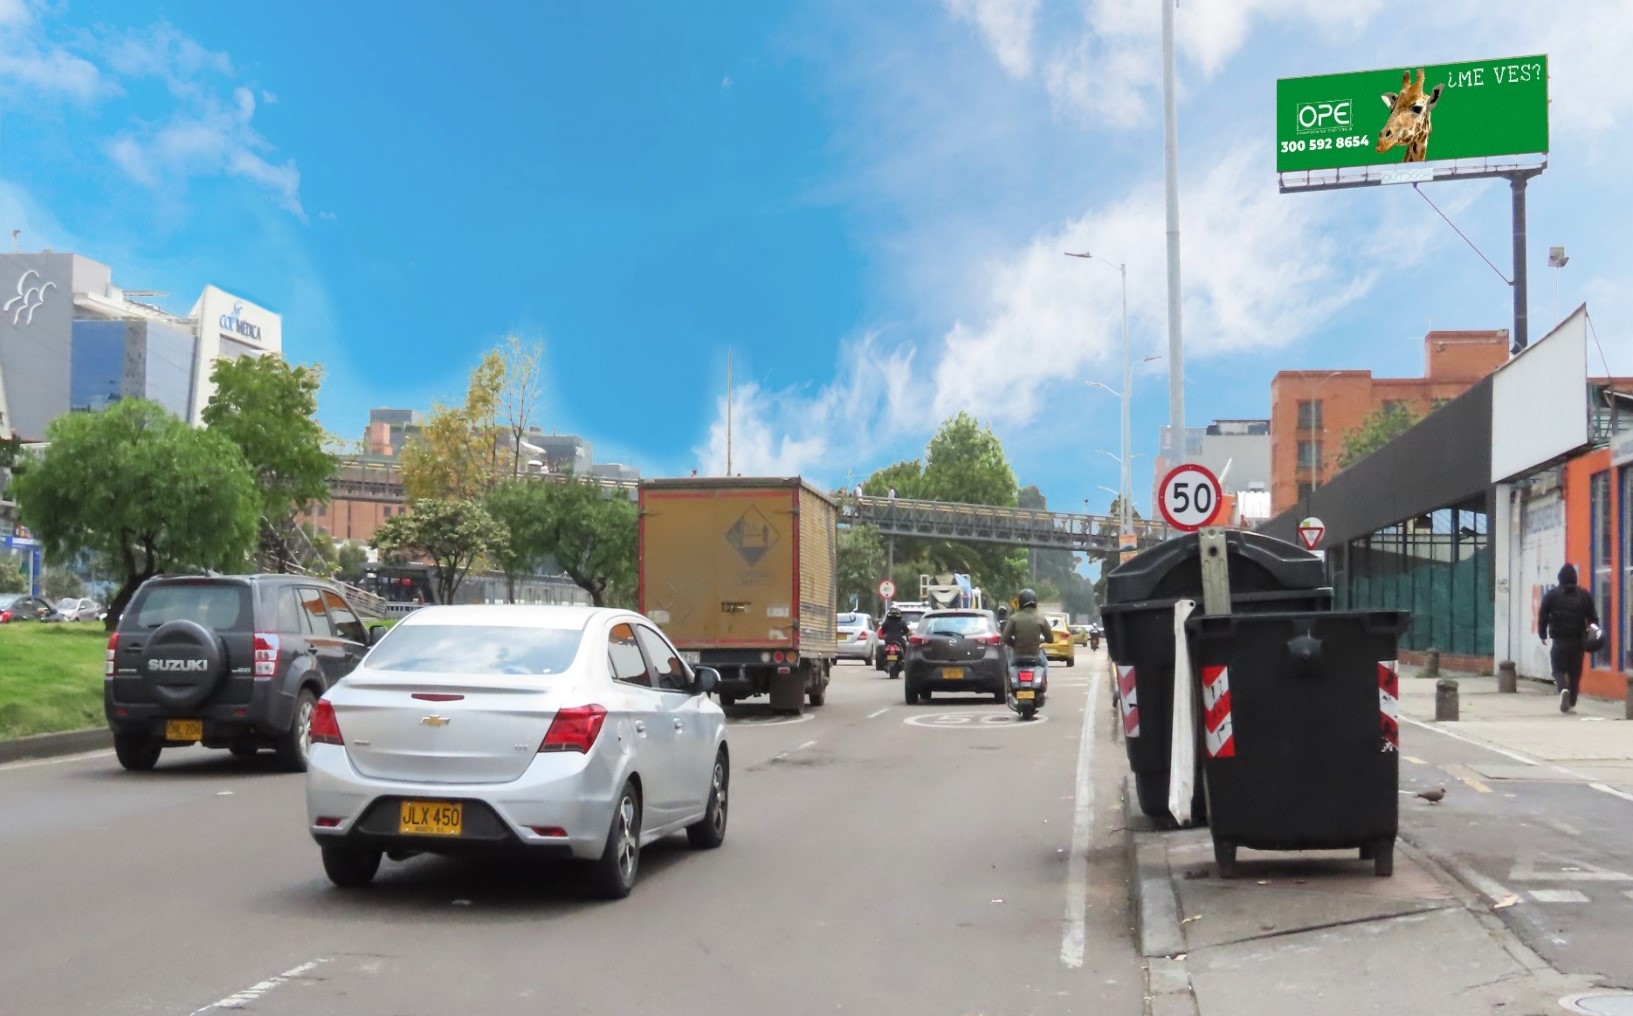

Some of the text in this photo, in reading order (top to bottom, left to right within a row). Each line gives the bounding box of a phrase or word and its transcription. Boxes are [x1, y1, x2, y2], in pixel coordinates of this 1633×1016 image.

[1447, 63, 1541, 88] ¿ME VES?
[1299, 102, 1350, 128] OPE
[1280, 134, 1370, 153] 300 592 8654
[1173, 482, 1211, 513] 50
[148, 658, 208, 672] SUZUKI
[403, 806, 460, 827] JLX 450
